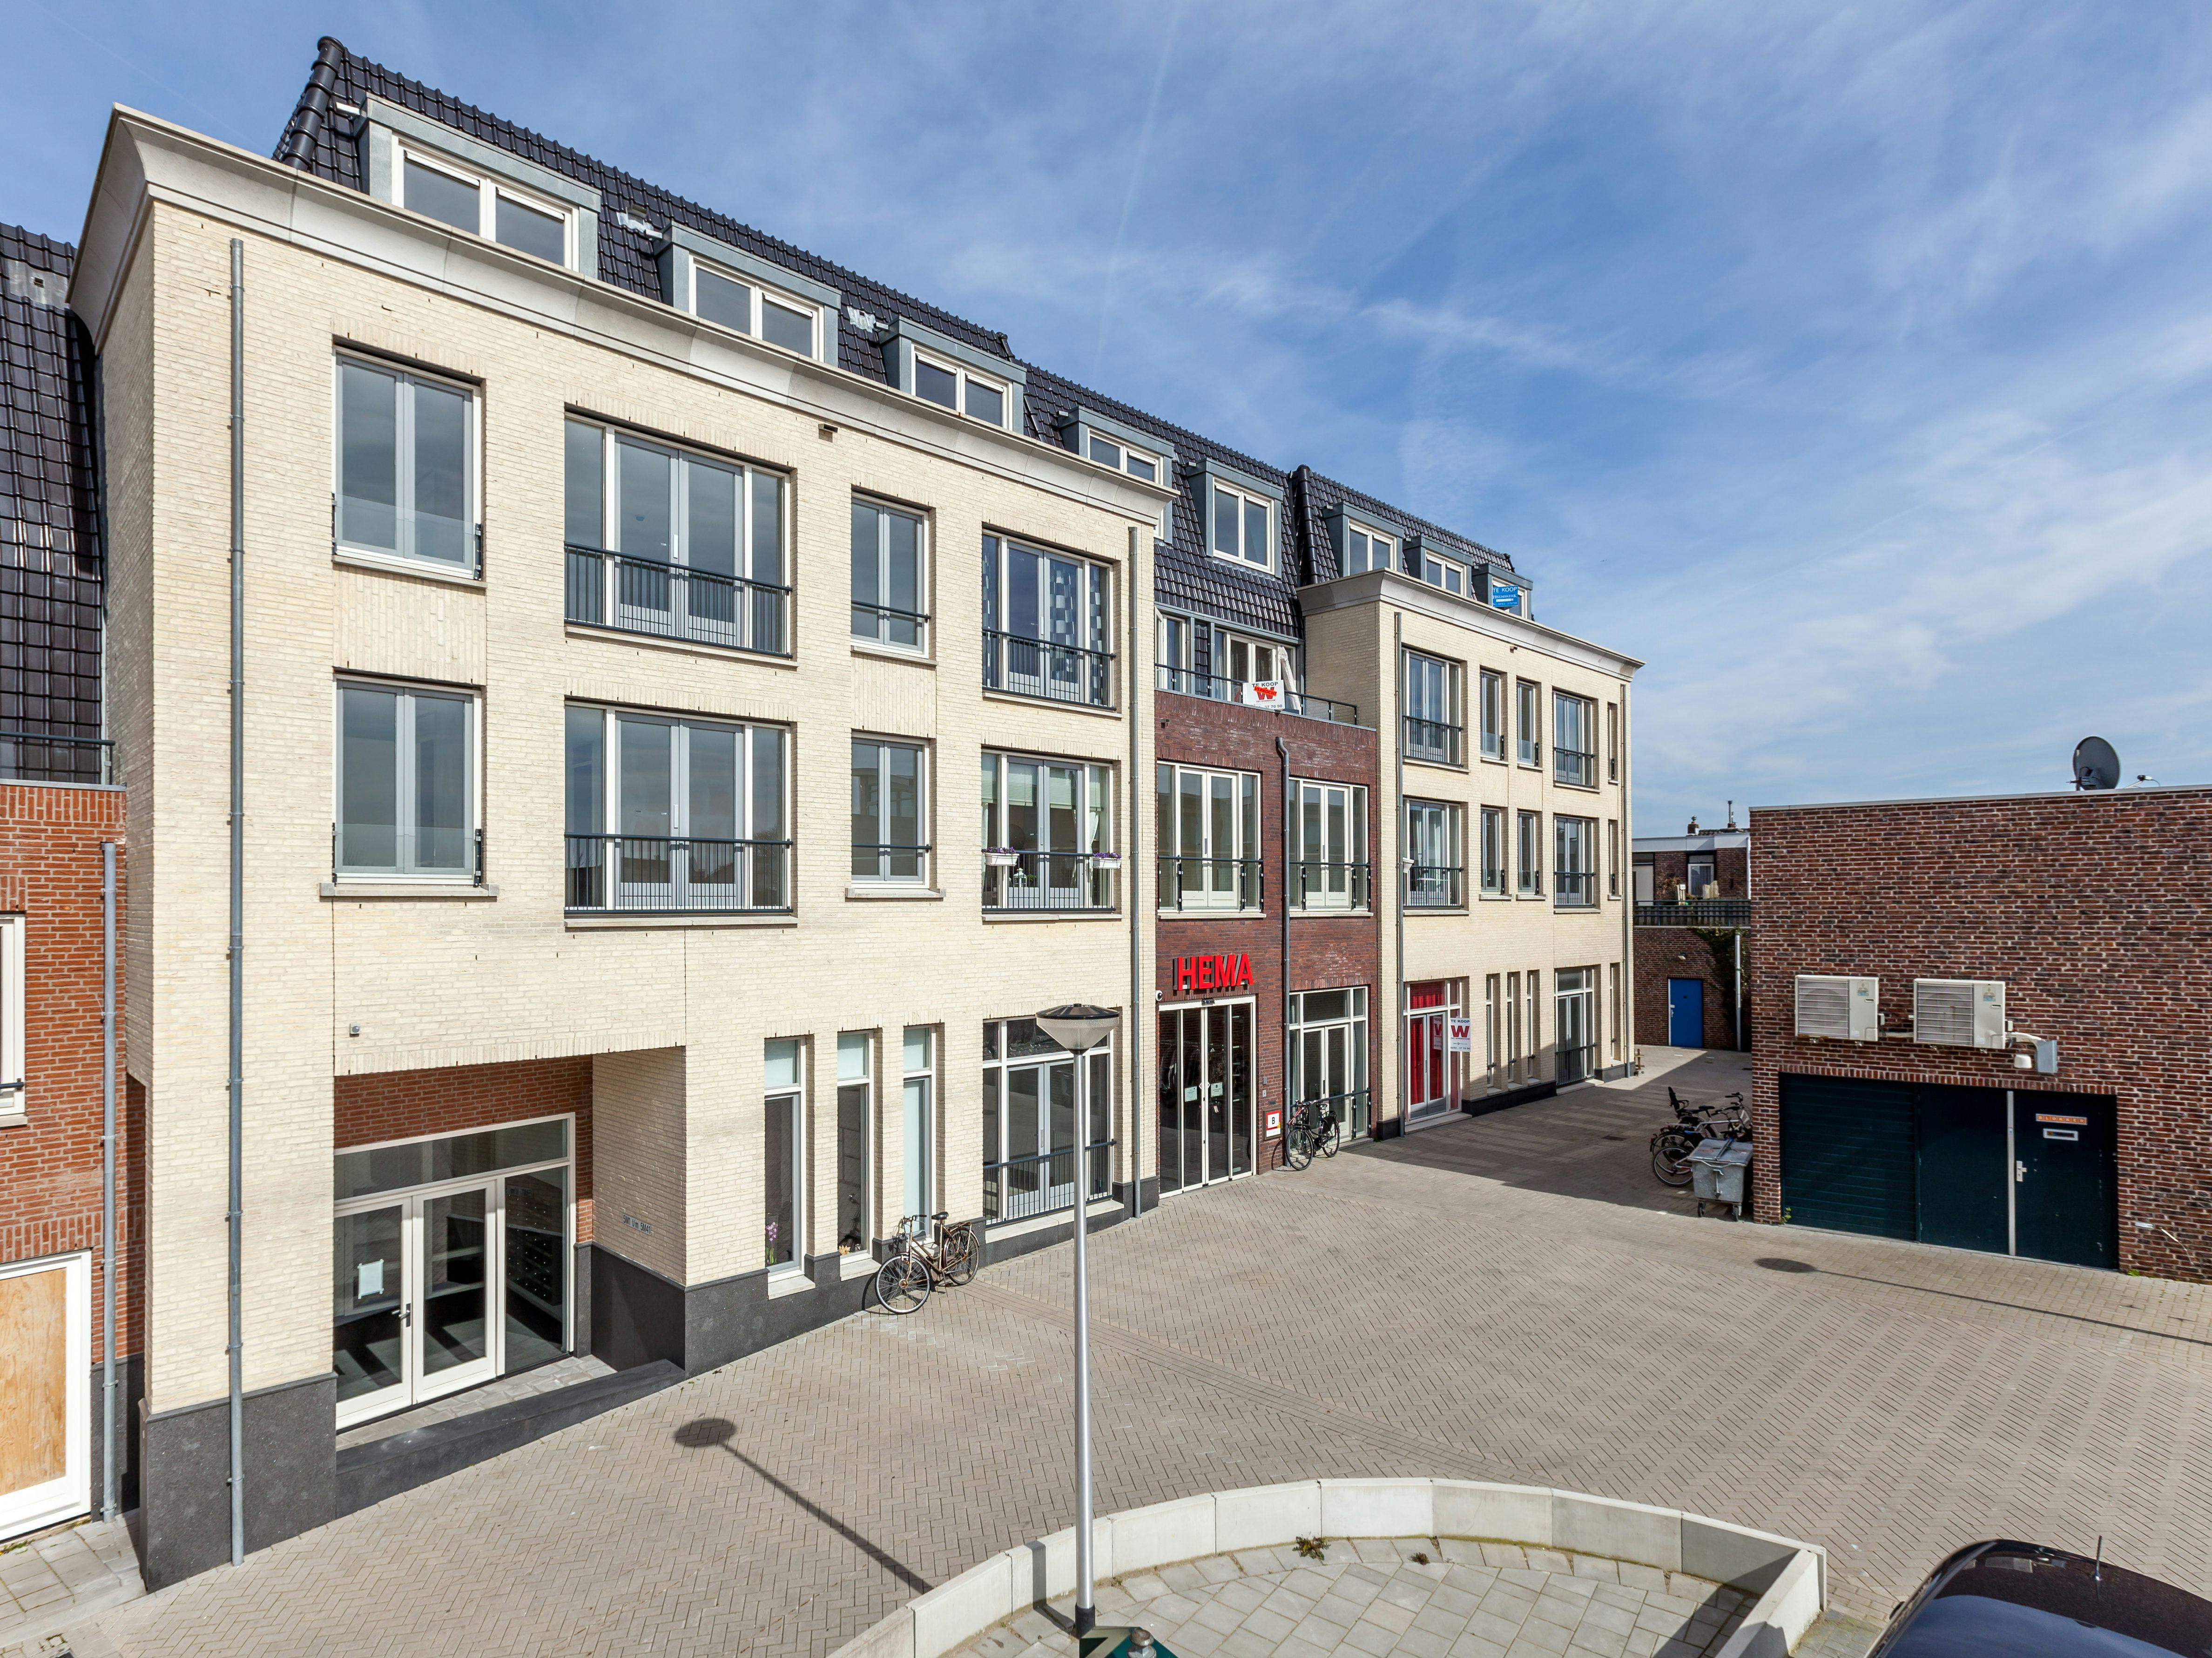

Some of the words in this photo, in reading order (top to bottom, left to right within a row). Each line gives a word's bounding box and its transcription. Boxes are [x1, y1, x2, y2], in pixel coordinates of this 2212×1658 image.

[1254, 686, 1277, 695] VERKOCHT
[1177, 954, 1254, 991] HEMA
[1450, 1025, 1470, 1038] W
